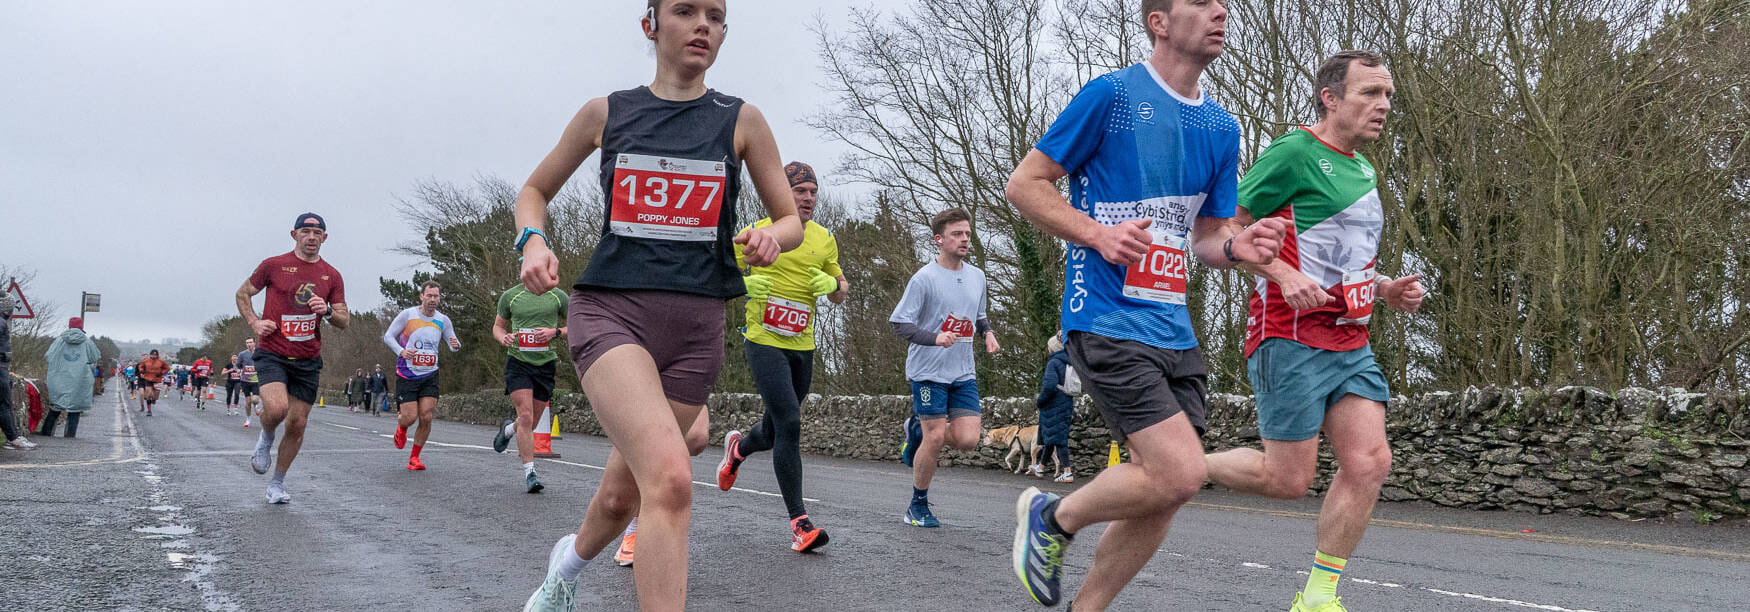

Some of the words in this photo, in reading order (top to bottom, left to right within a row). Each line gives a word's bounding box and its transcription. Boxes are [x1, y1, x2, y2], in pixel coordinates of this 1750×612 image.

[619, 174, 721, 211] 1377
[637, 213, 668, 224] POPPY
[669, 215, 701, 226] JONES
[767, 305, 808, 327] 1706
[414, 355, 435, 363] 1631
